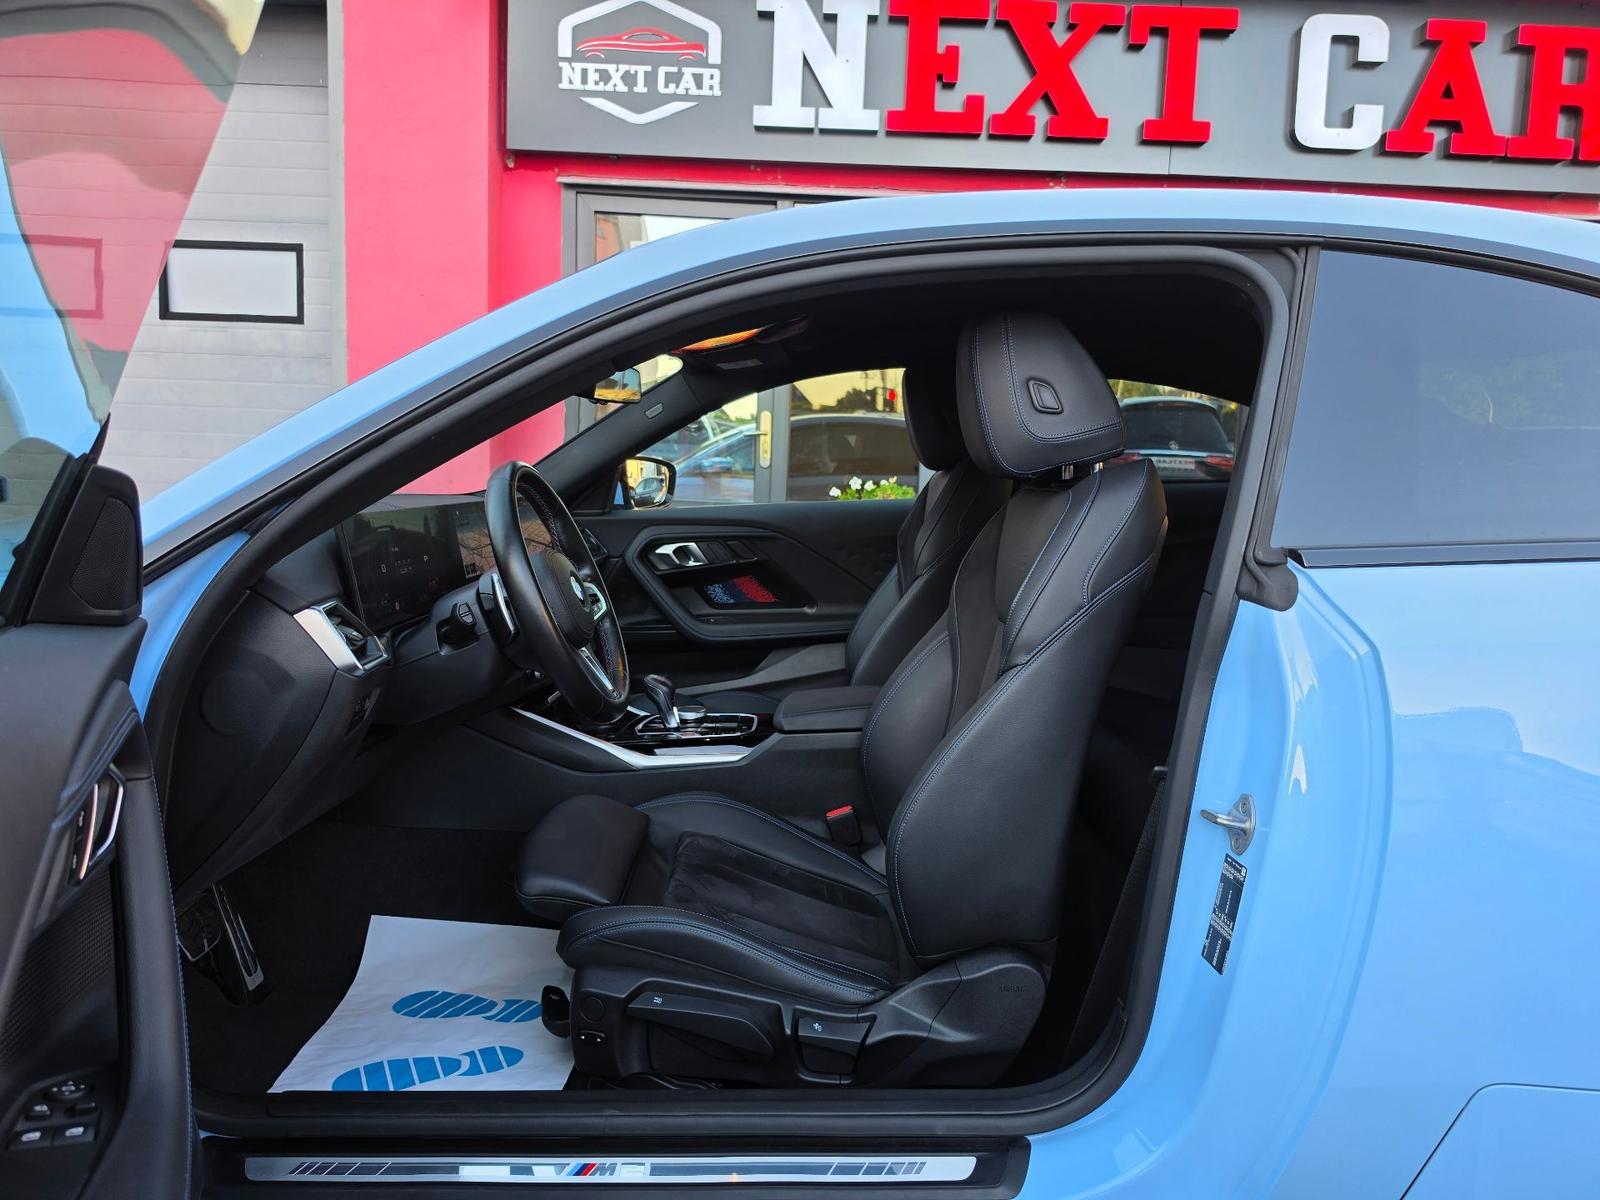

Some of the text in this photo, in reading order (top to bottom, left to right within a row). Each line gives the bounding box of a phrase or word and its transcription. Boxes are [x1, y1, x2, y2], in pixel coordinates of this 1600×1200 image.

[558, 61, 722, 97] NEXT CAR
[753, 0, 1600, 162] NEXT CAR
